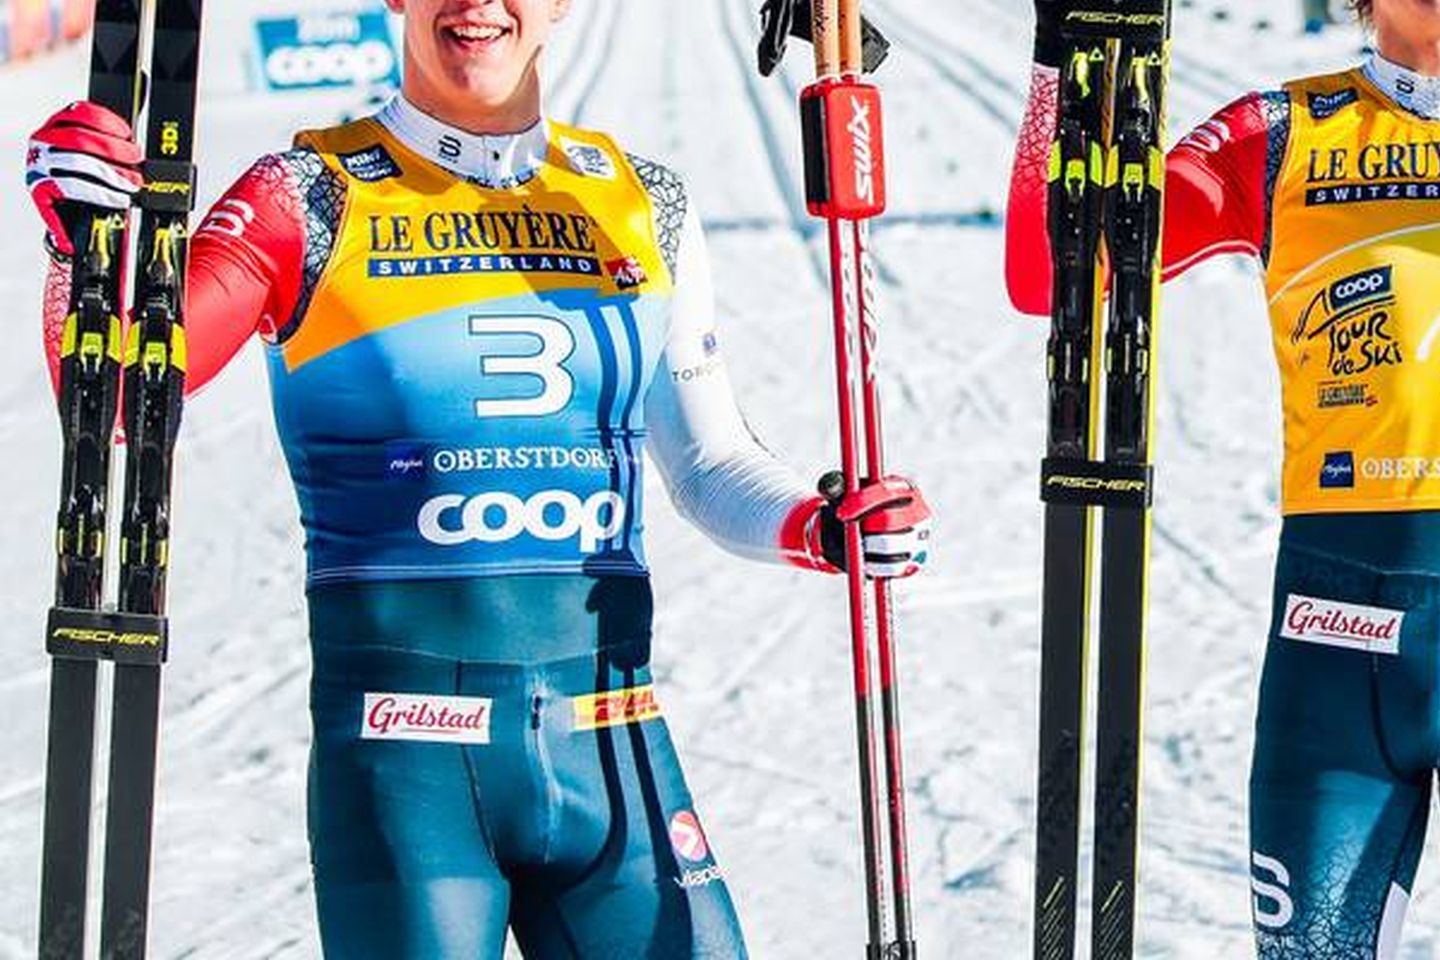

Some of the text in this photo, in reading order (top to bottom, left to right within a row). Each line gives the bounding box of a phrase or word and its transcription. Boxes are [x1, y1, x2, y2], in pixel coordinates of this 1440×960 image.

[1065, 10, 1168, 27] FISCHER
[847, 94, 874, 206] SWIX
[1305, 147, 1348, 183] LE
[368, 204, 597, 253] LE GRUYÈRE
[378, 255, 593, 276] SWITZERLAND
[1336, 273, 1384, 299] coop
[469, 314, 577, 419] 3
[434, 445, 618, 473] OBERSTDORF
[1047, 475, 1146, 491] FISCHER
[417, 489, 627, 553] coop
[53, 628, 159, 646] FISCHER
[1288, 601, 1397, 640] Grilstad
[367, 696, 486, 731] Grilstad
